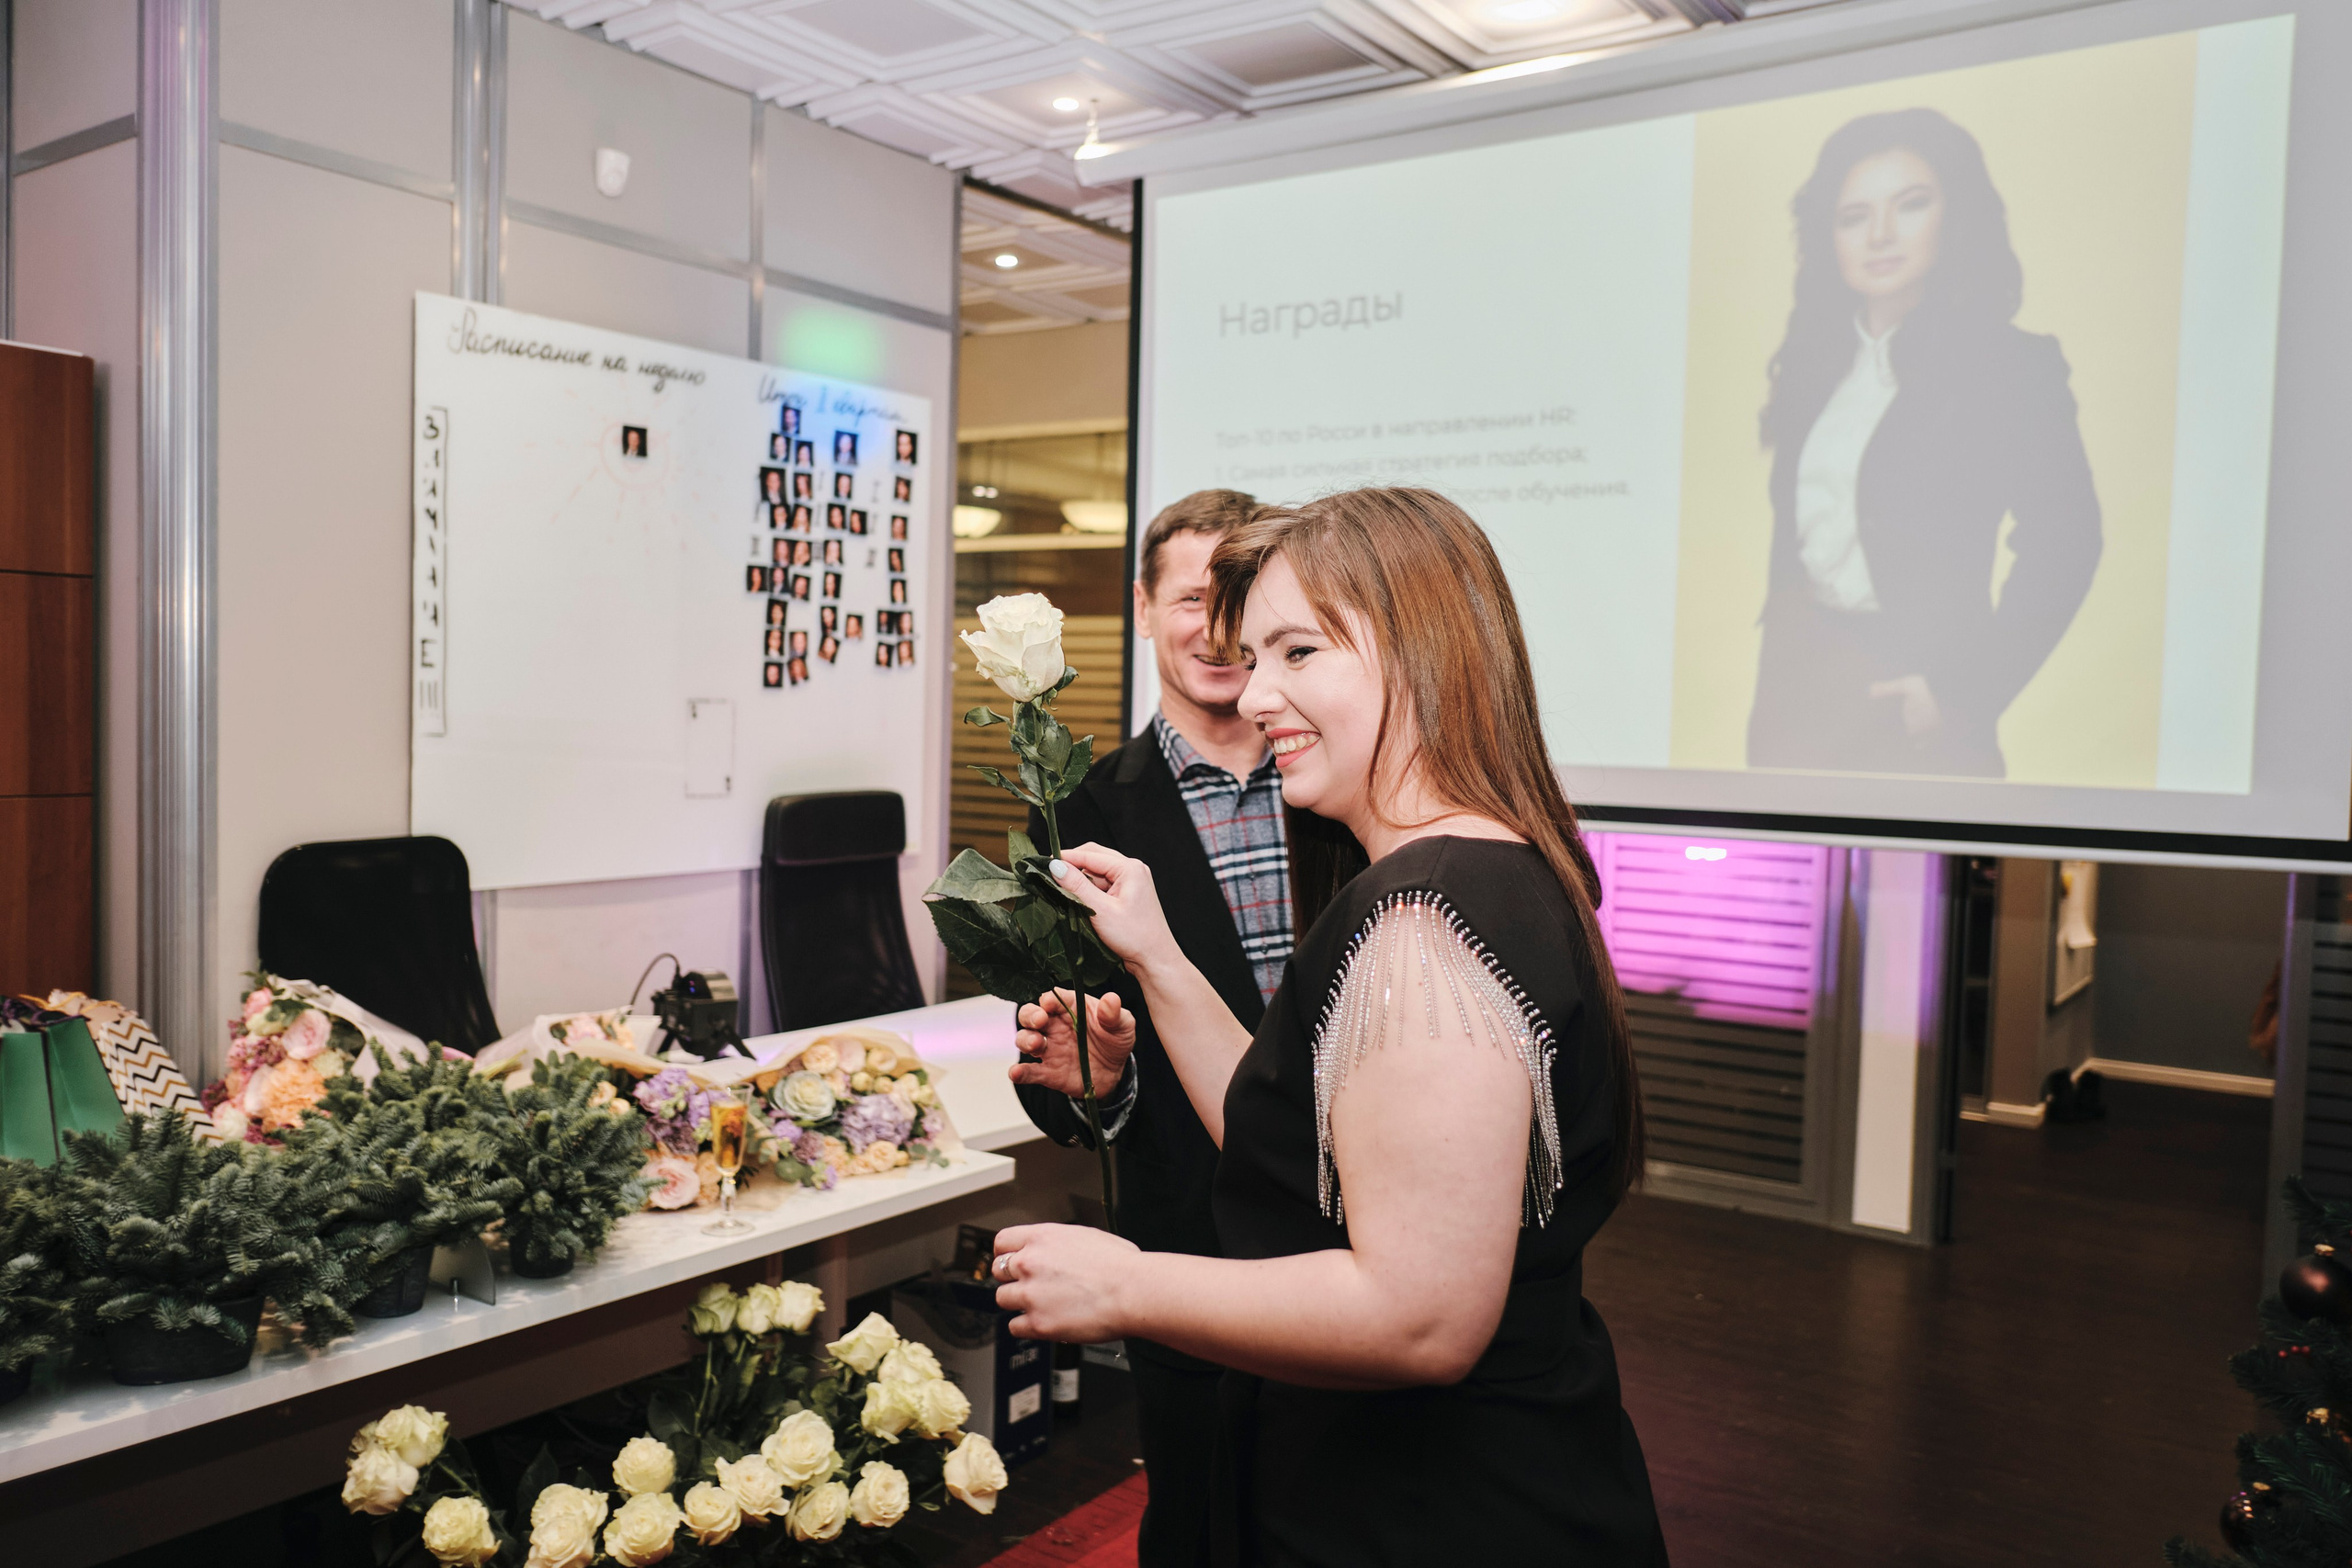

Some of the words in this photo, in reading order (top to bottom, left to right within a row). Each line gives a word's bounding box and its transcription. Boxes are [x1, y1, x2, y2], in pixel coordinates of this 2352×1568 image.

[447, 306, 593, 367] Расписание
[602, 353, 628, 373] на
[1218, 291, 1403, 340] Награды
[1278, 429, 1303, 446] по
